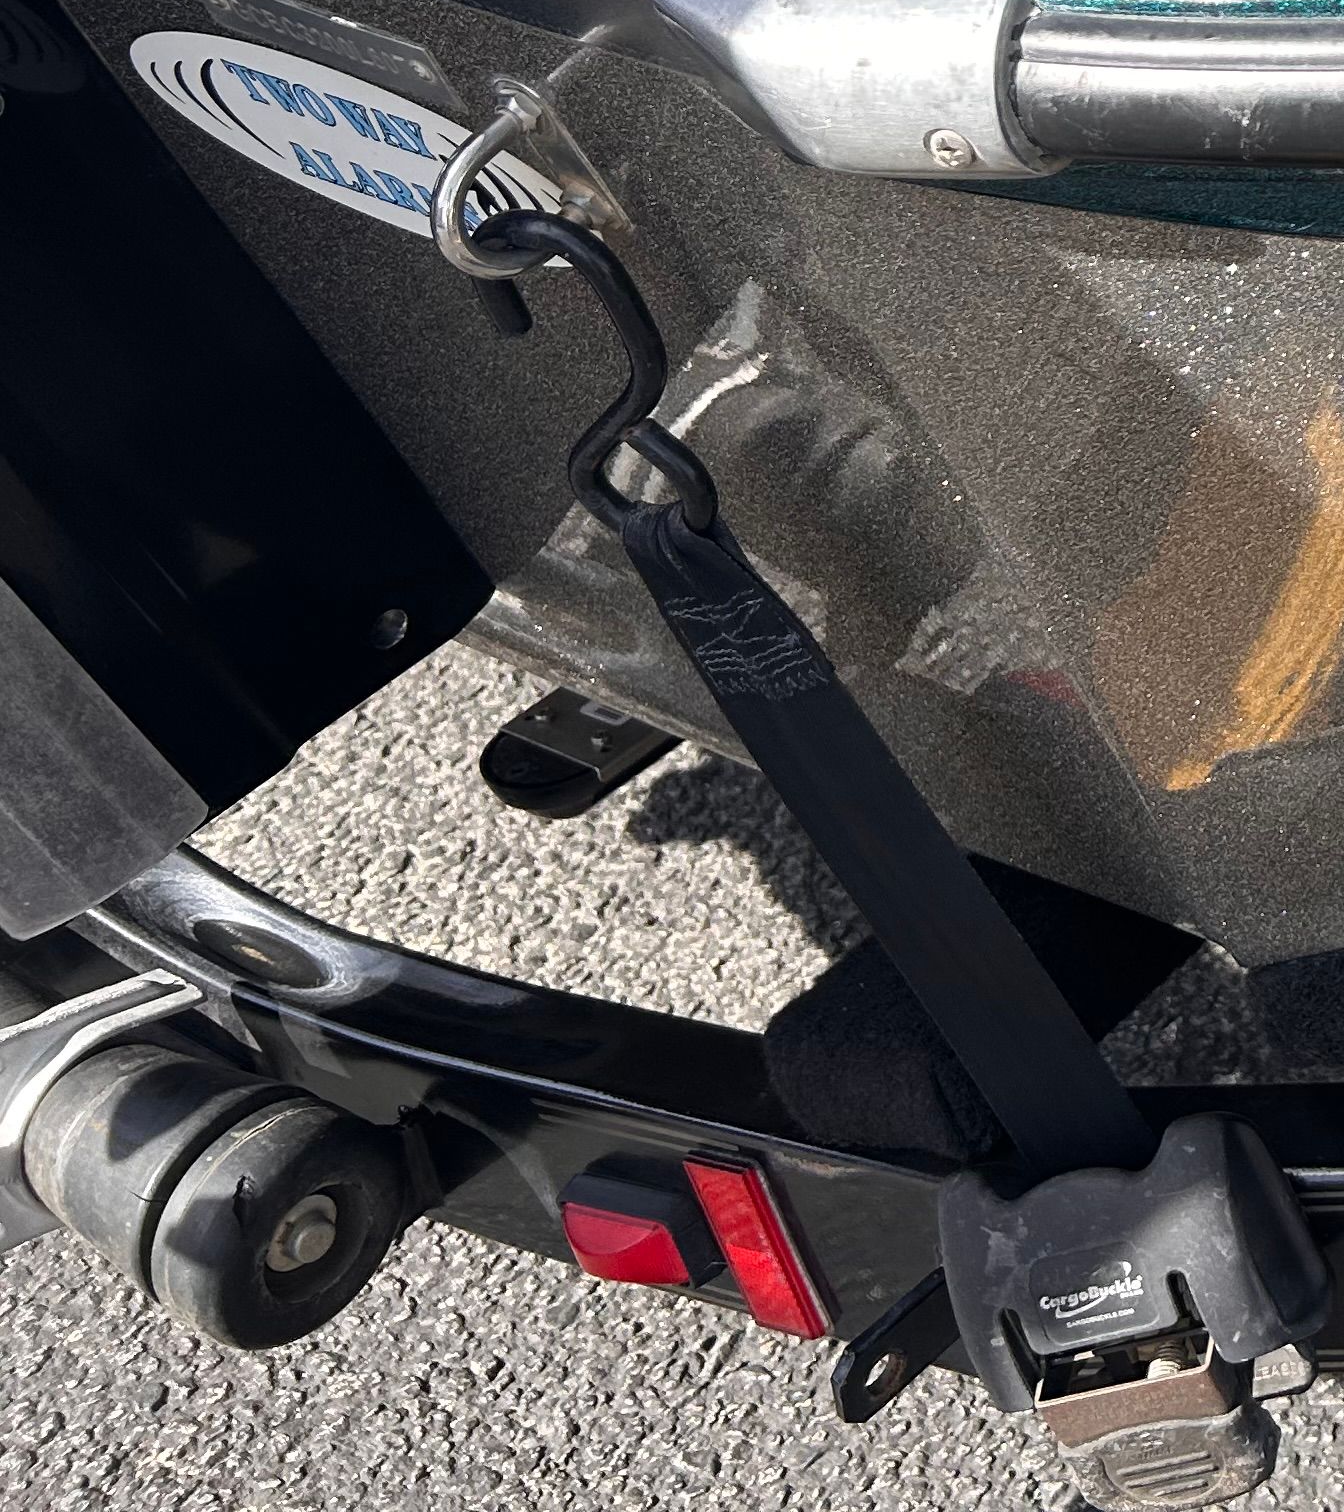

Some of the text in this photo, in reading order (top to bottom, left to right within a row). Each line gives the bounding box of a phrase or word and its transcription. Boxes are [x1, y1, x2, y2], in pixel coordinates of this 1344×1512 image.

[220, 58, 437, 161] TWO WAY
[1039, 1277, 1142, 1310] CargoBuckle
